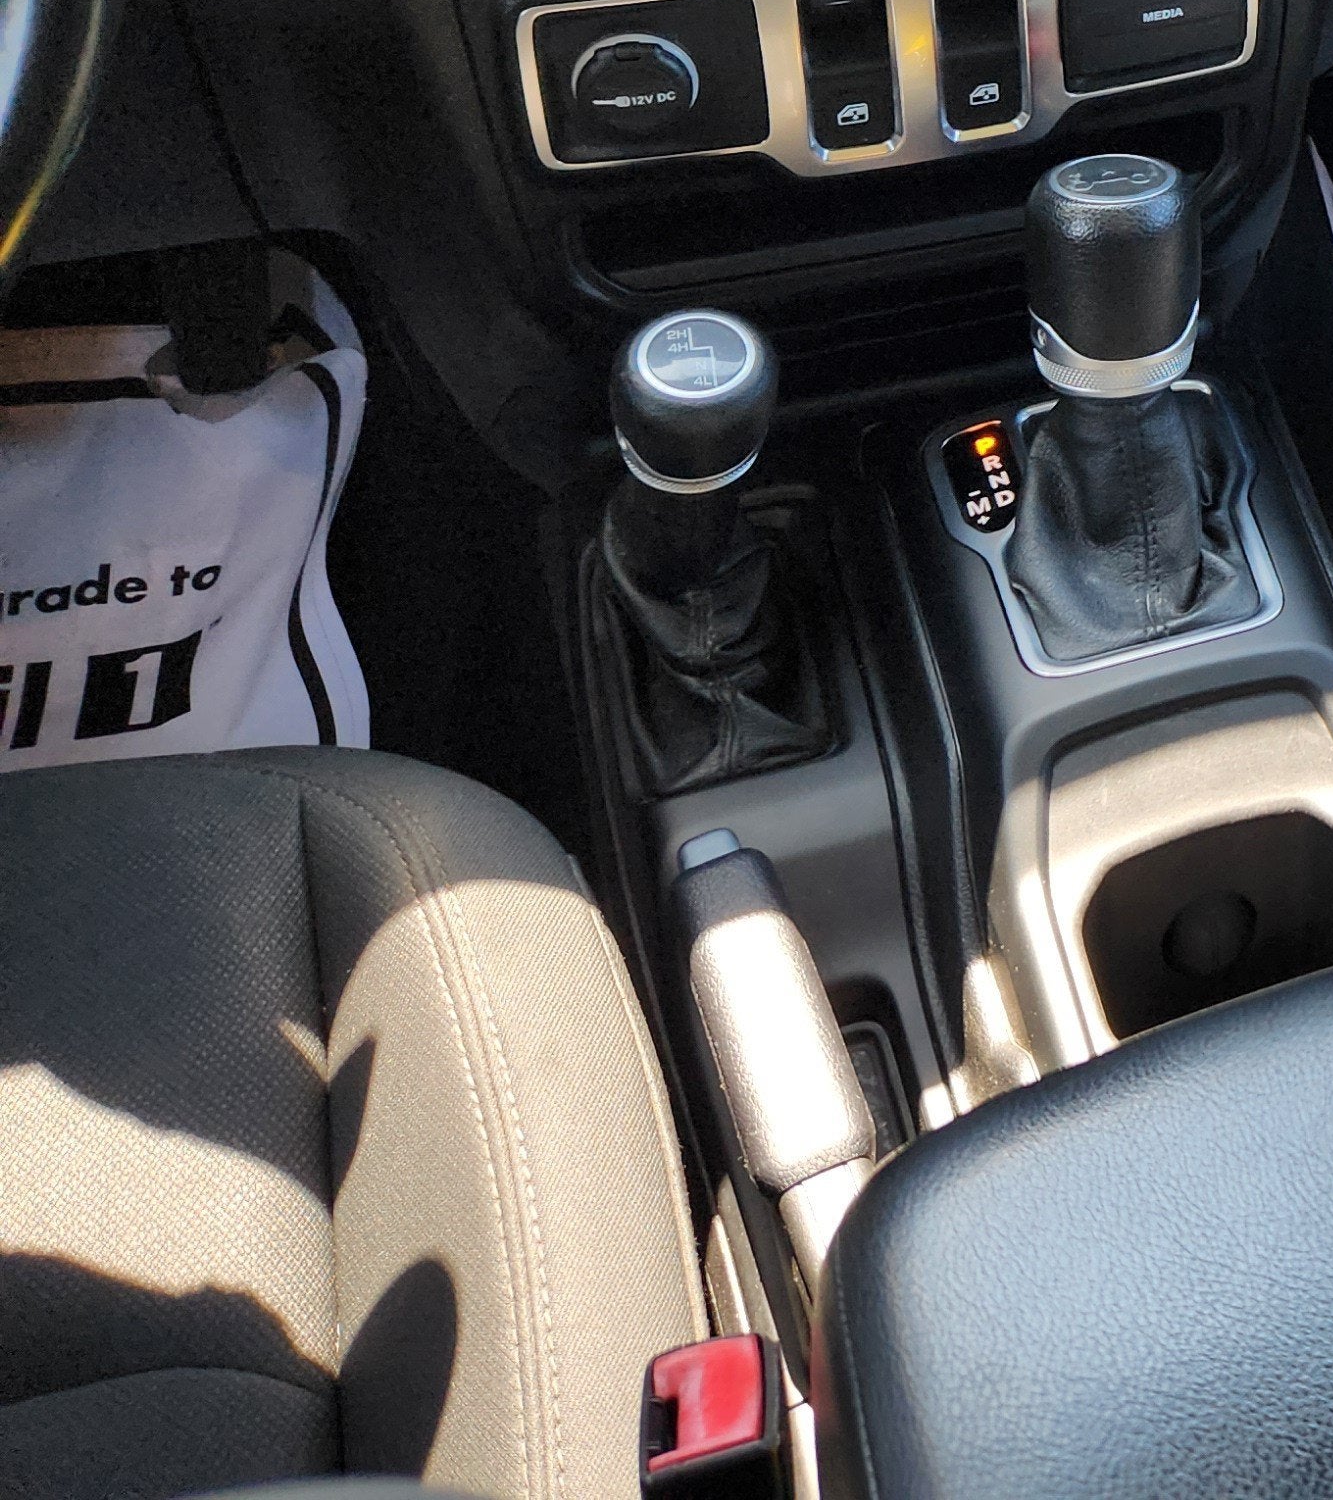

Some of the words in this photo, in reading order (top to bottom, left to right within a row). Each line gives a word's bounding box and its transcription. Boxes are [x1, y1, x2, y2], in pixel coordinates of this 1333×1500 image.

[1142, 7, 1184, 23] MEDIA
[631, 94, 654, 107] 12V
[656, 90, 677, 104] DC
[666, 328, 688, 341] 2H
[667, 341, 689, 353] 4H
[693, 376, 713, 387] 4L
[975, 436, 996, 456] P
[981, 454, 1004, 472] R
[988, 470, 1011, 490] N
[966, 496, 992, 518] M
[994, 489, 1016, 508] D
[0, 563, 148, 619] rade
[170, 564, 222, 596] to
